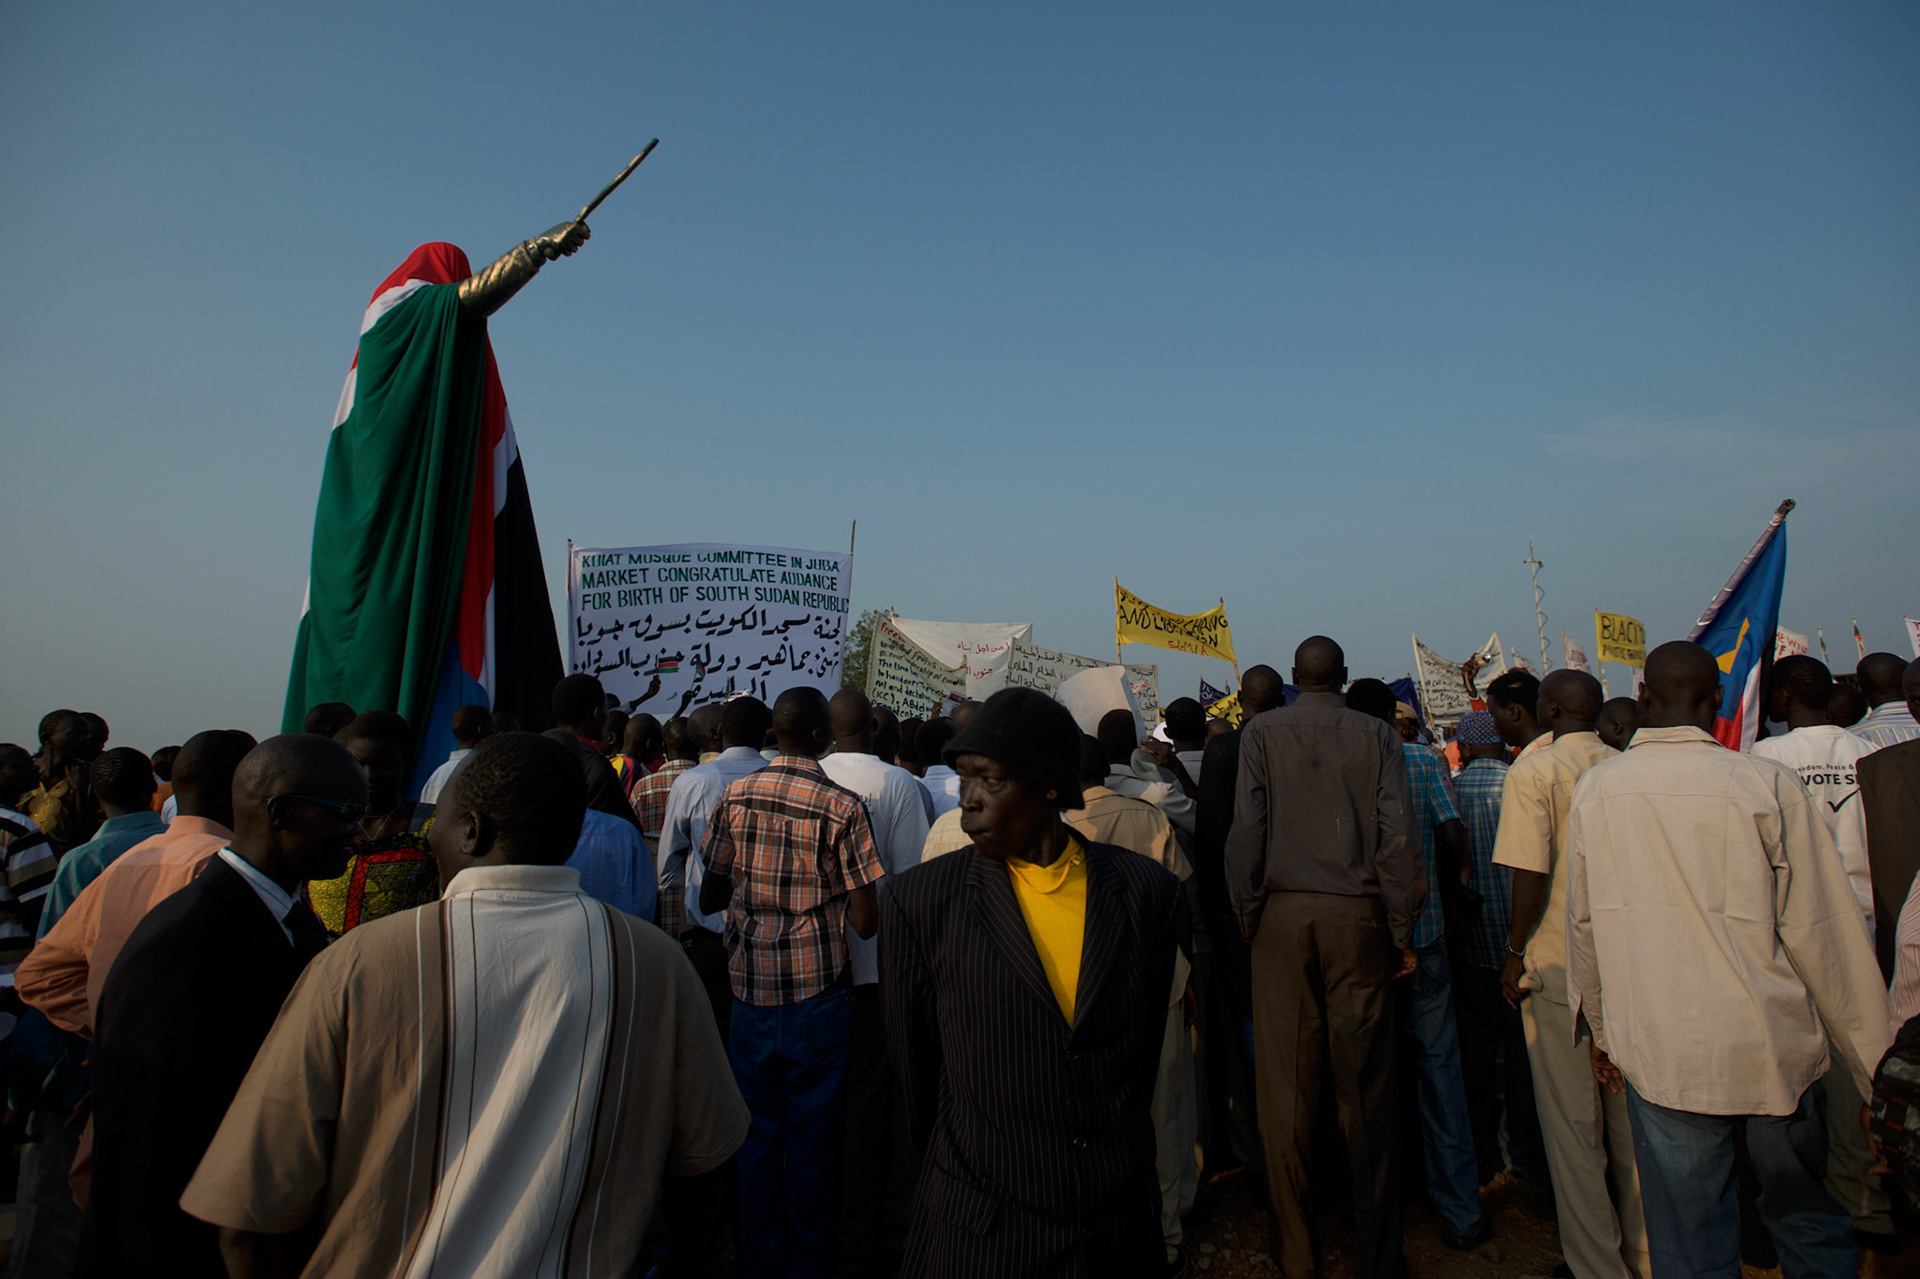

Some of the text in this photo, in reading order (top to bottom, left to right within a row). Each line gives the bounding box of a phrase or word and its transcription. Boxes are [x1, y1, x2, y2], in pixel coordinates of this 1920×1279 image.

[697, 550, 787, 567] COMMITTEE
[791, 556, 803, 569] IN
[806, 558, 840, 573] JUBA
[582, 568, 649, 589] MARKET
[658, 566, 776, 583] CONGRATULATE
[582, 593, 612, 611] FOR
[618, 587, 664, 608] BIRTH
[670, 586, 694, 604] OF
[696, 586, 749, 602] SOUTH
[755, 587, 800, 606] SUDAN
[696, 604, 767, 636] الكويت
[1793, 764, 1825, 773] reedom,
[1801, 774, 1841, 786] VOTE
